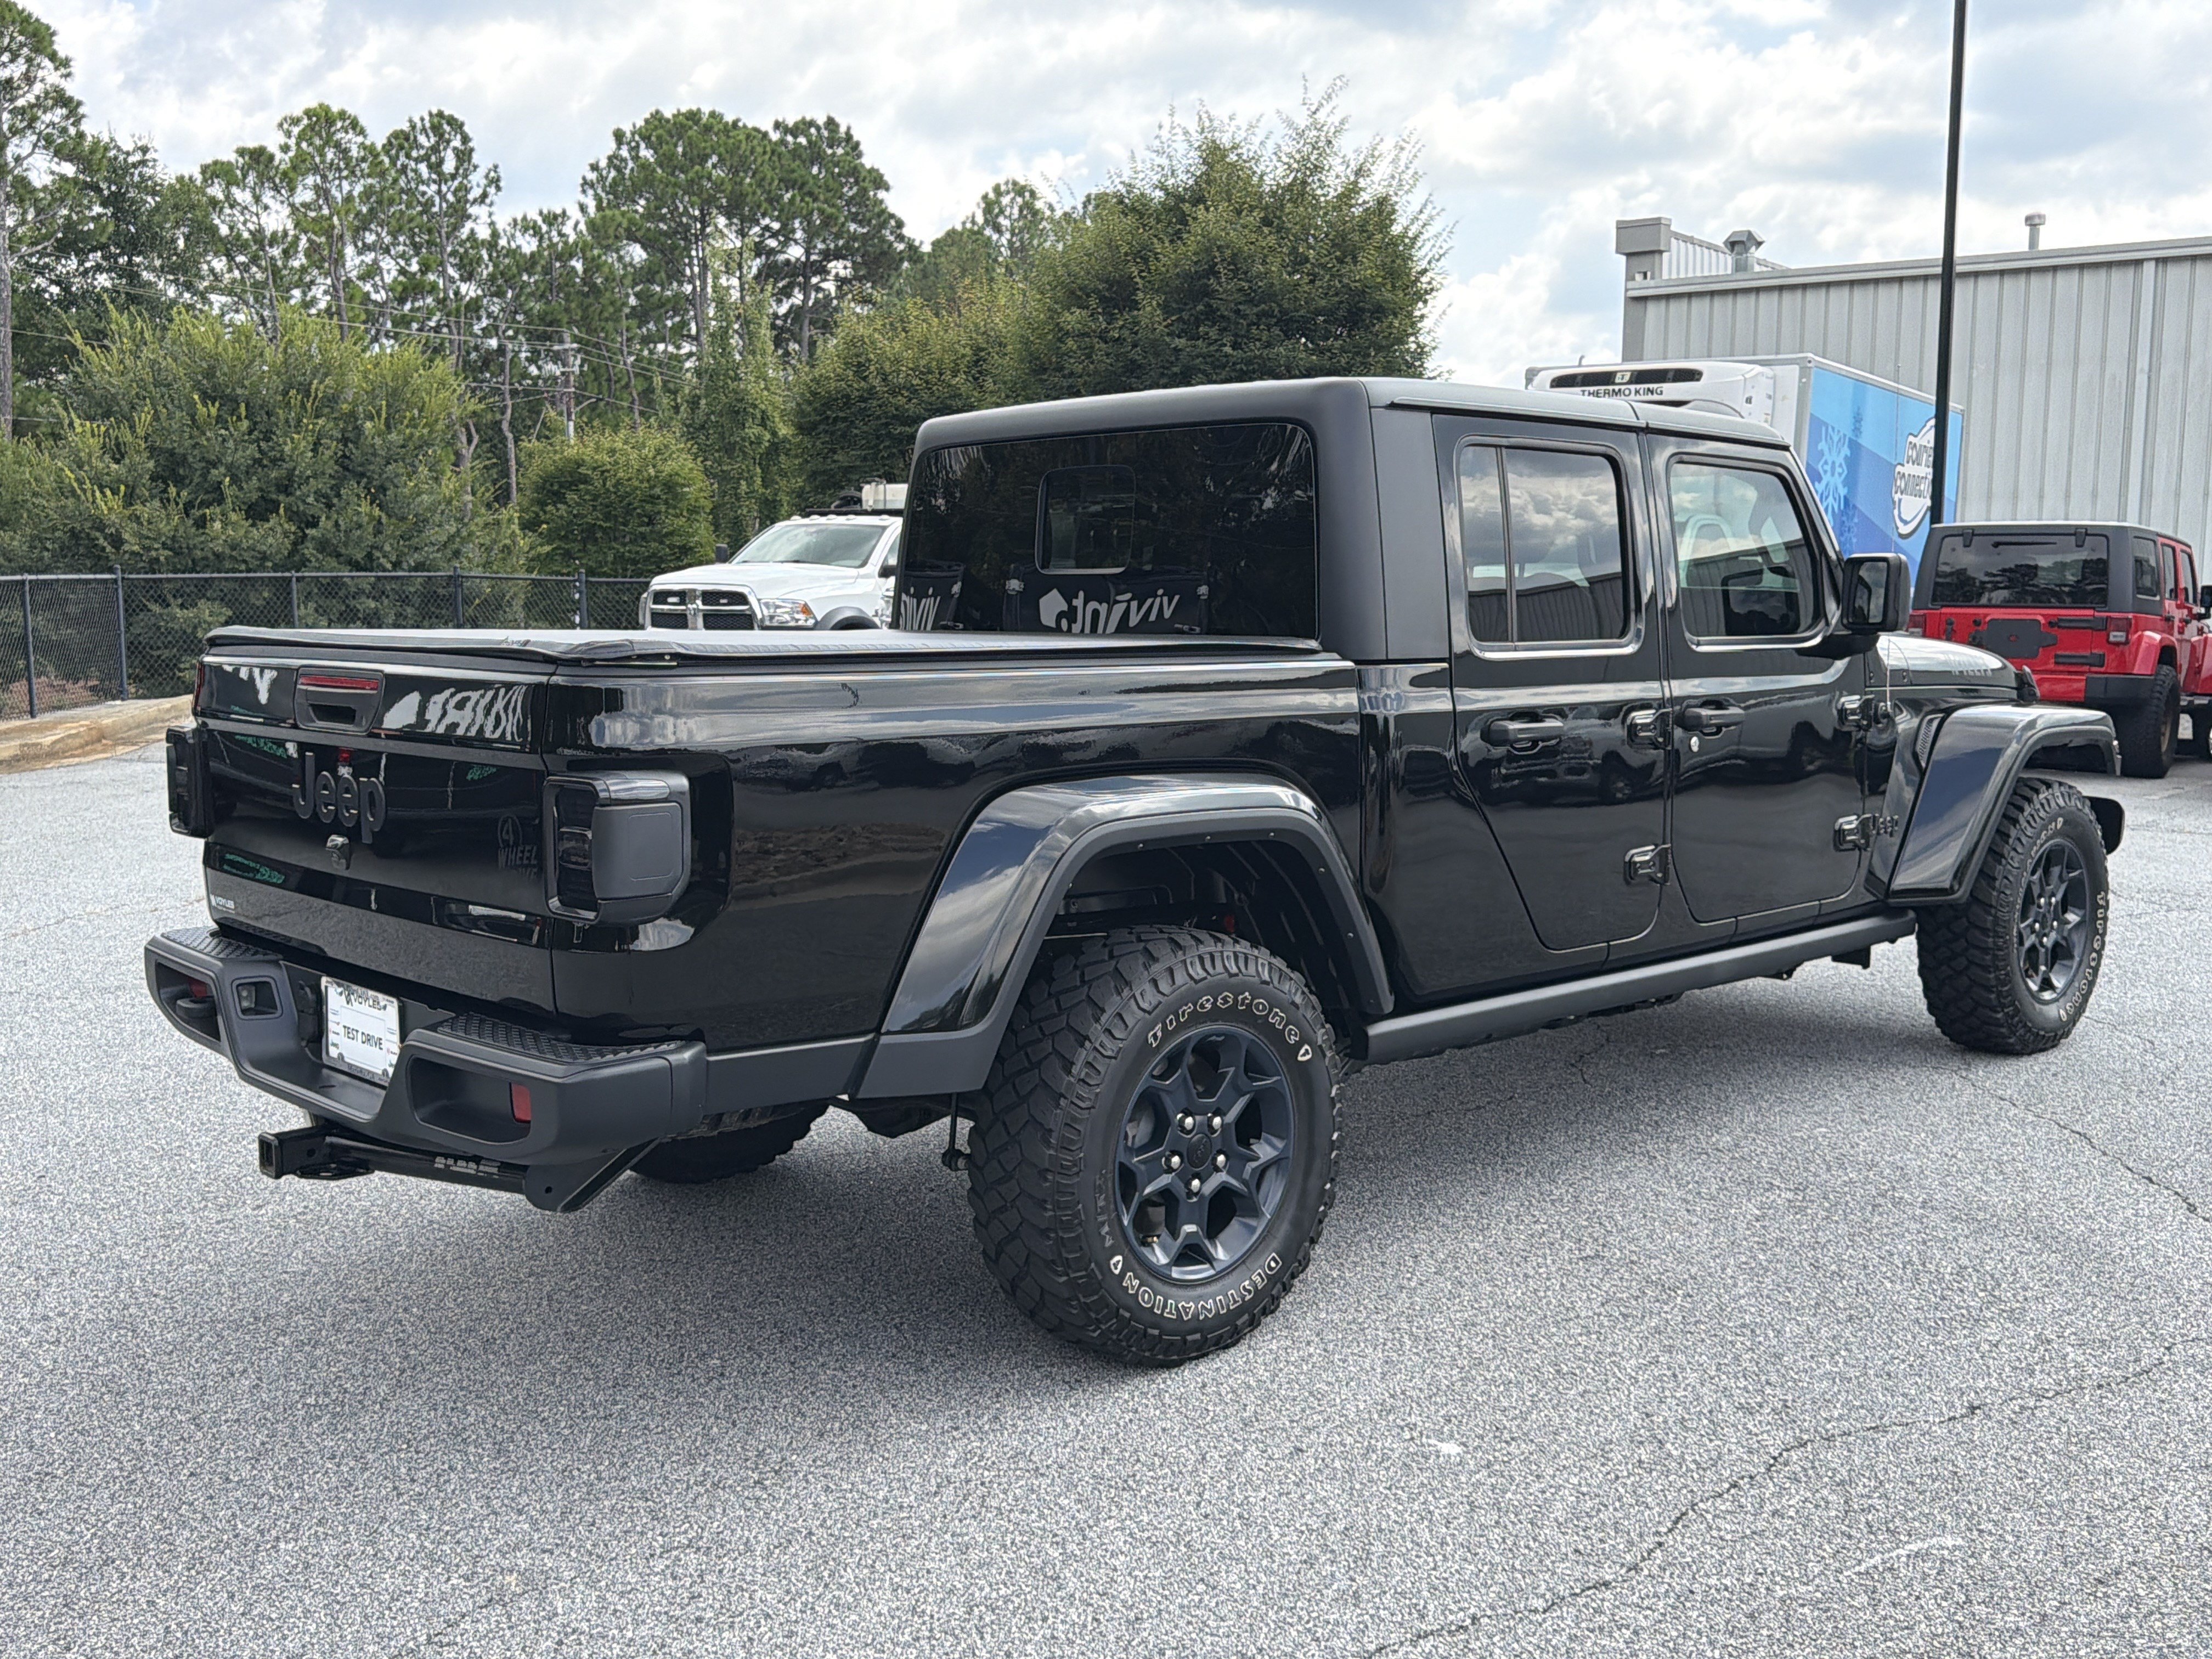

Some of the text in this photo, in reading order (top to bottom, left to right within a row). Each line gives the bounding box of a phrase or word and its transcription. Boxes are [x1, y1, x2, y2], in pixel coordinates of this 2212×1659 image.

[1581, 386, 1663, 398] THERMO KING
[292, 752, 385, 844] Jeep
[498, 845, 538, 868] WHEEL
[342, 1024, 383, 1051] TEST DRIVE
[1148, 991, 1300, 1047] Firestone
[1122, 1252, 1282, 1321] DESTINATION
